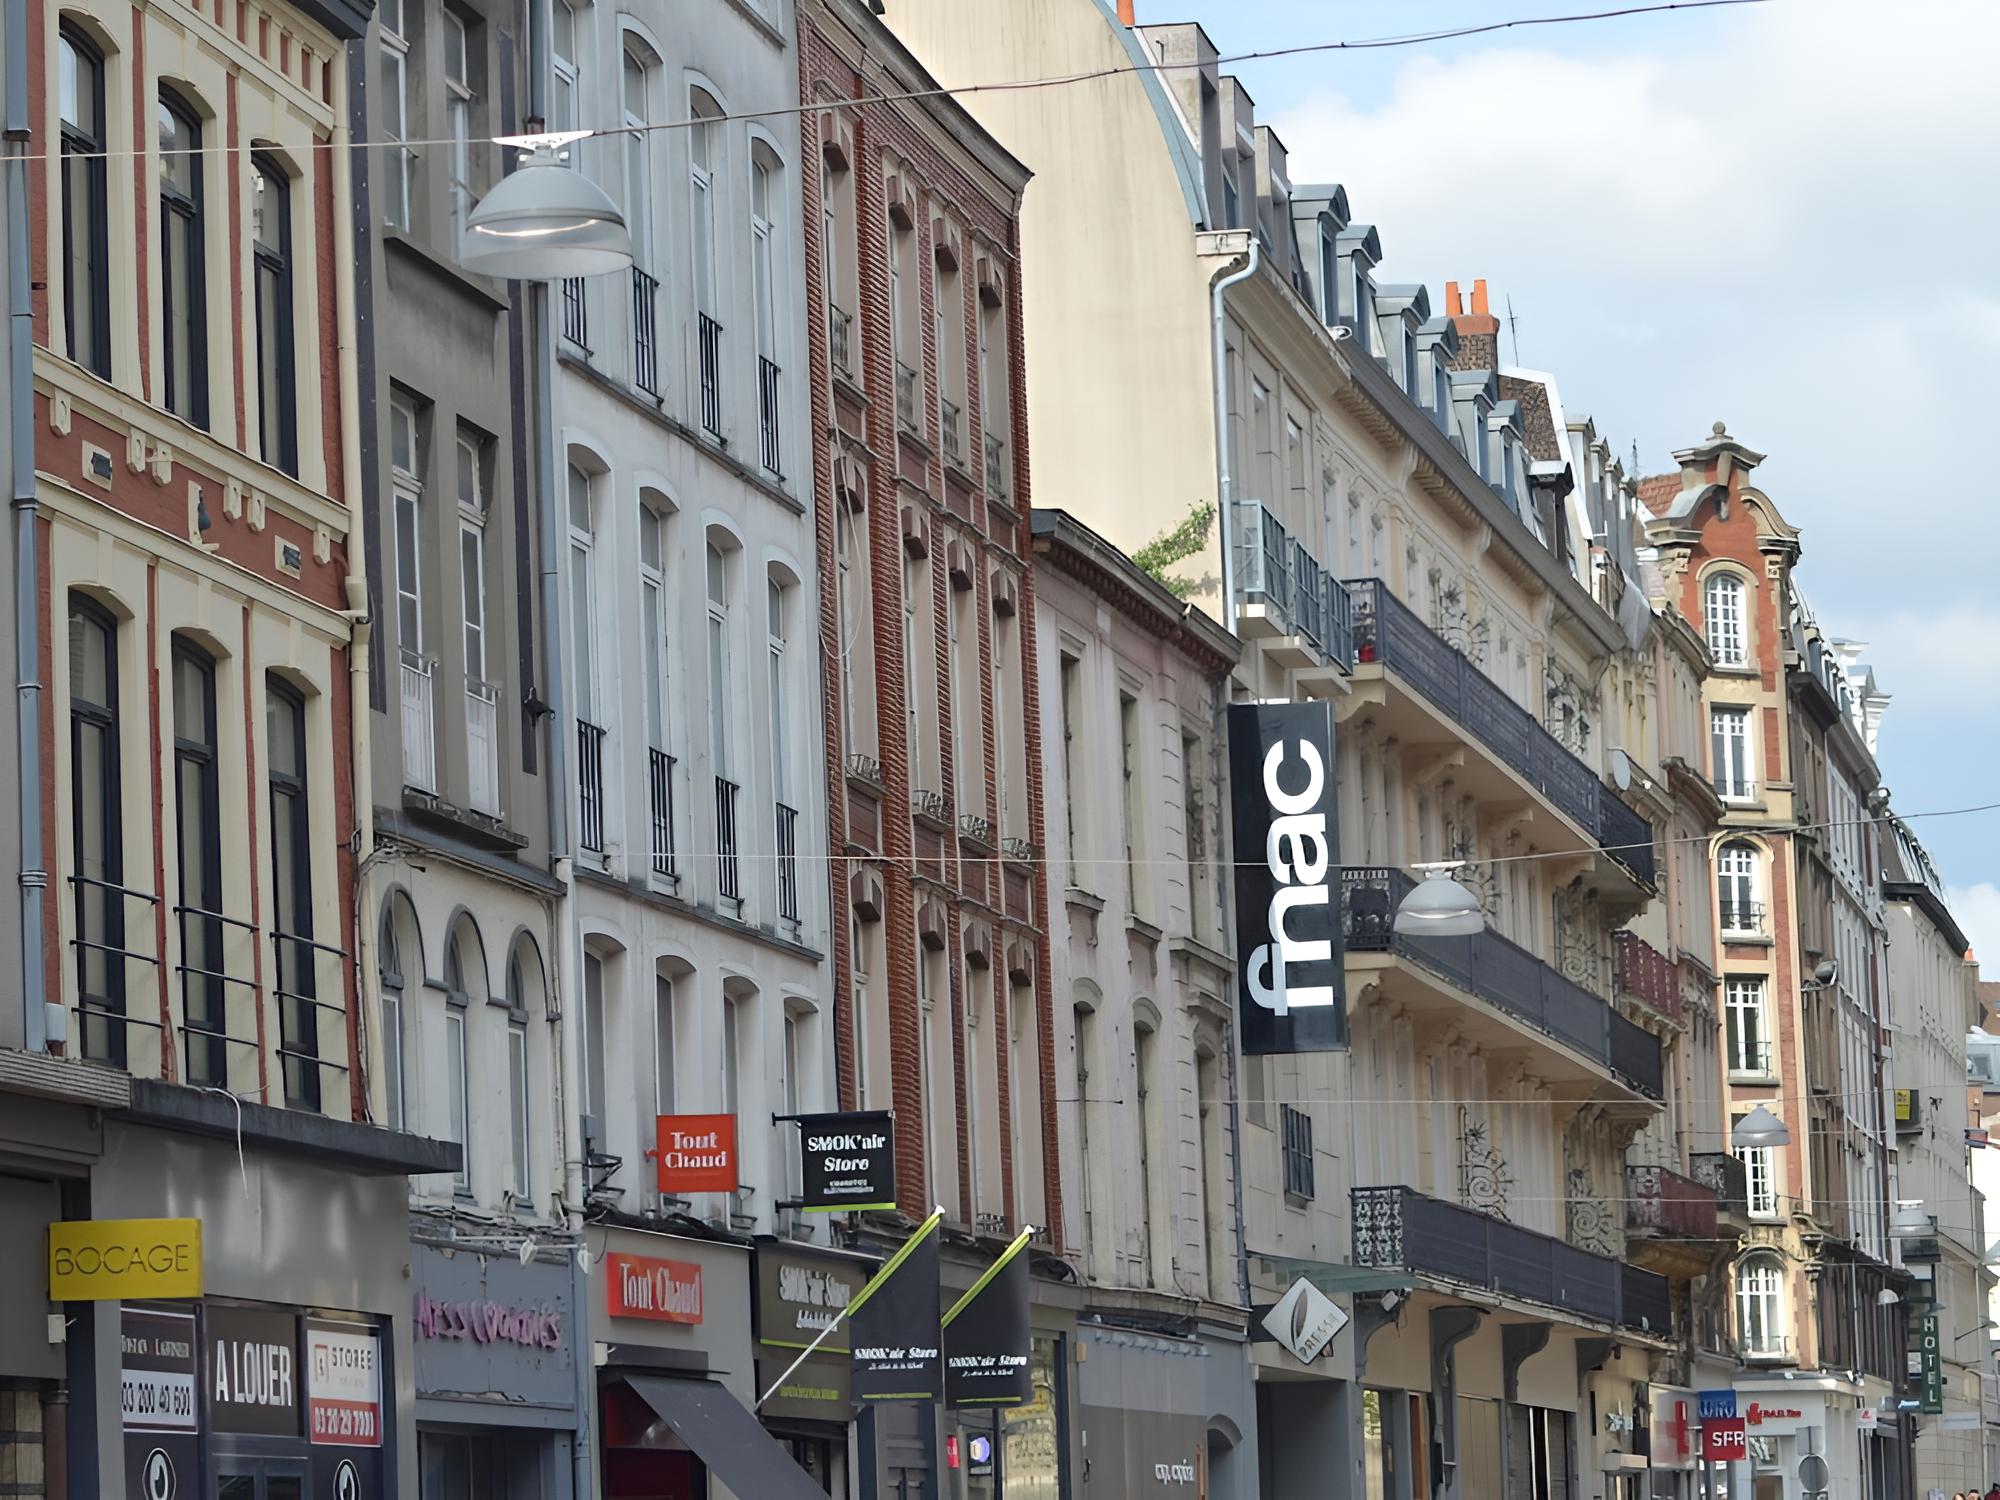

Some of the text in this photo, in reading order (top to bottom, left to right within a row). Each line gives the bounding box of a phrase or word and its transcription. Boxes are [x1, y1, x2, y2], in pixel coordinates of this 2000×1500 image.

[1247, 739, 1333, 1016] fnac
[671, 1132, 718, 1149] Tout
[665, 1151, 727, 1168] Chaud
[824, 1156, 869, 1172] Store
[55, 1244, 189, 1276] BOCAGE
[620, 1263, 701, 1325] Tout Chaud
[216, 1340, 292, 1406] A LOUER
[1923, 1317, 1937, 1403] HOTEL
[1712, 1431, 1745, 1447] SFR
